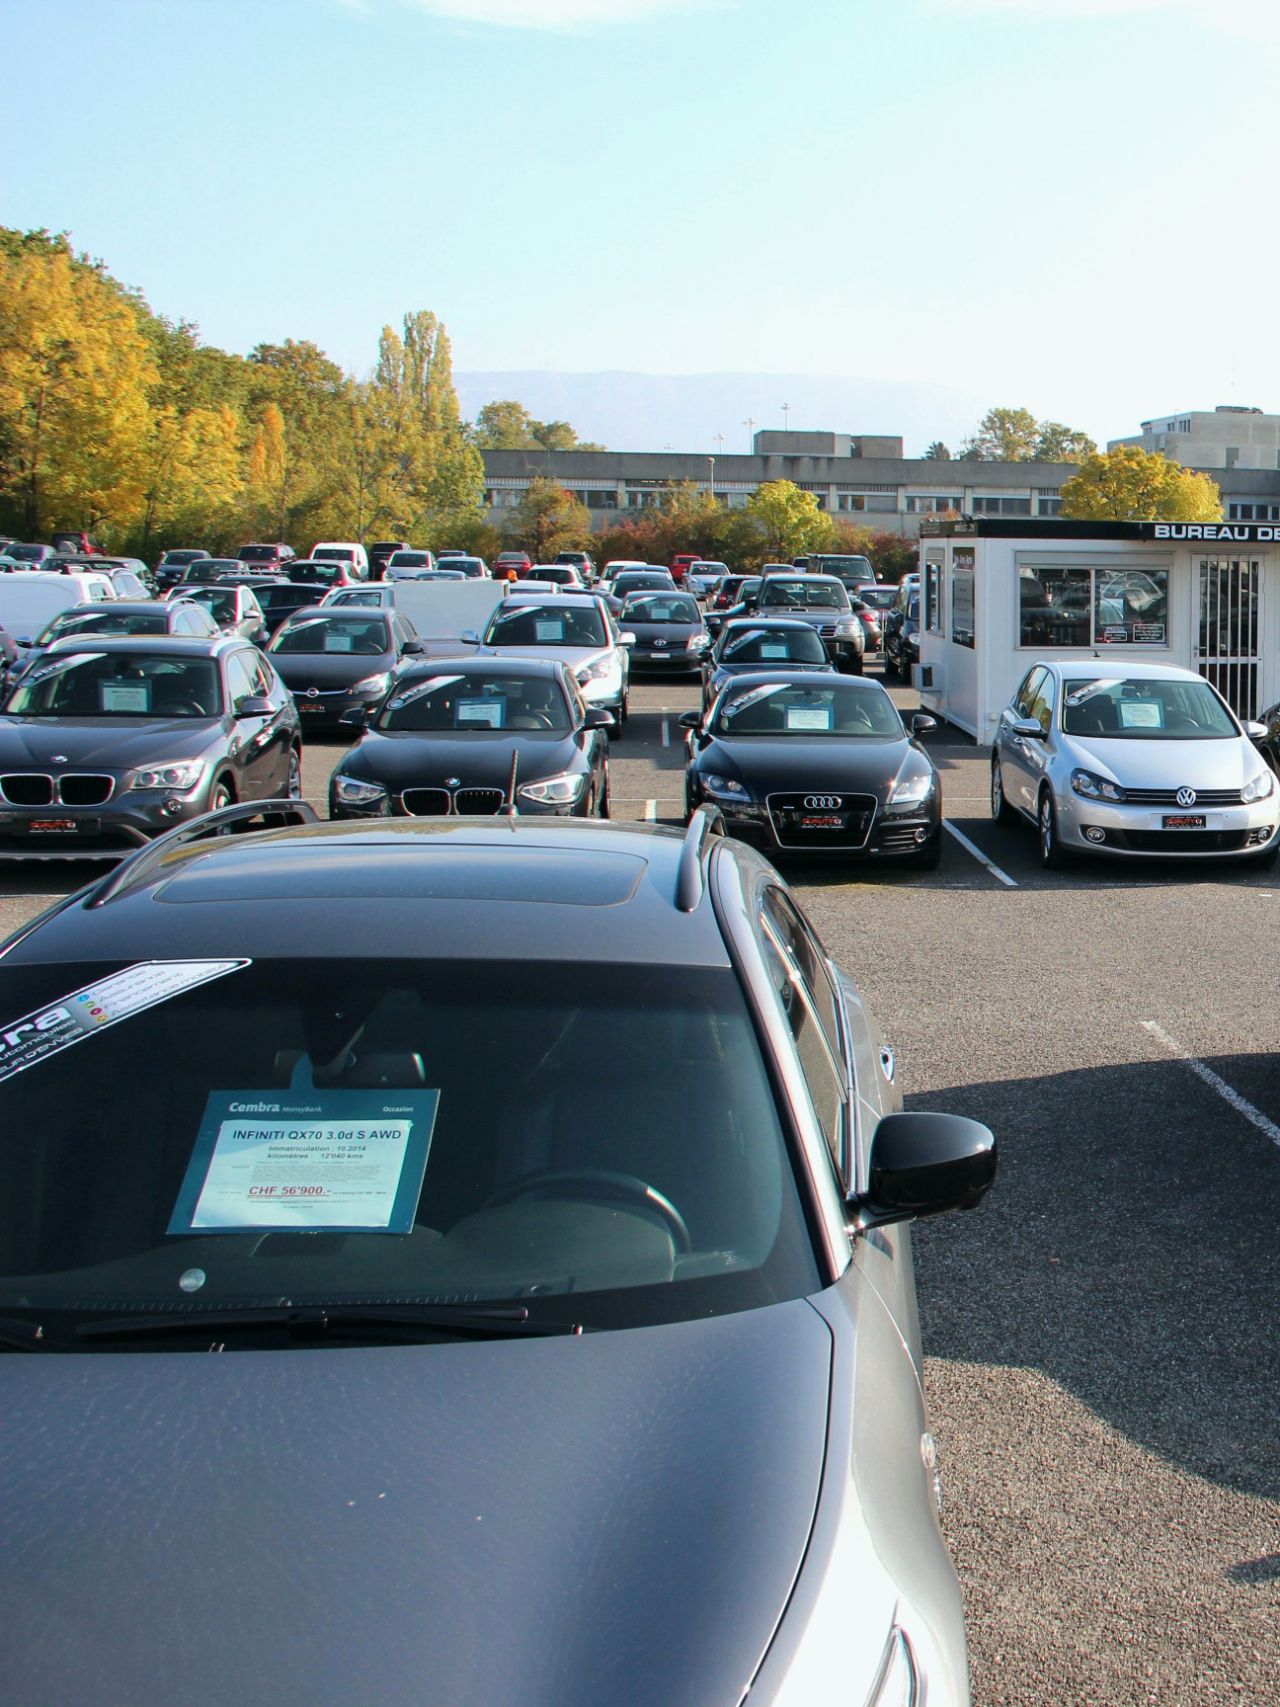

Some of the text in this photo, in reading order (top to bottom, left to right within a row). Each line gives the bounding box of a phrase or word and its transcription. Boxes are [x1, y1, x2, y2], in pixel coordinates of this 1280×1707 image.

[1154, 524, 1250, 541] BUREAU
[229, 1102, 323, 1114] Cembra MoneyBank
[382, 1105, 414, 1113] Occasion
[233, 1130, 402, 1141] INFINITI QX70 3.0d S AWD
[249, 1185, 278, 1196] CHF
[280, 1185, 332, 1196] 56'900.-
